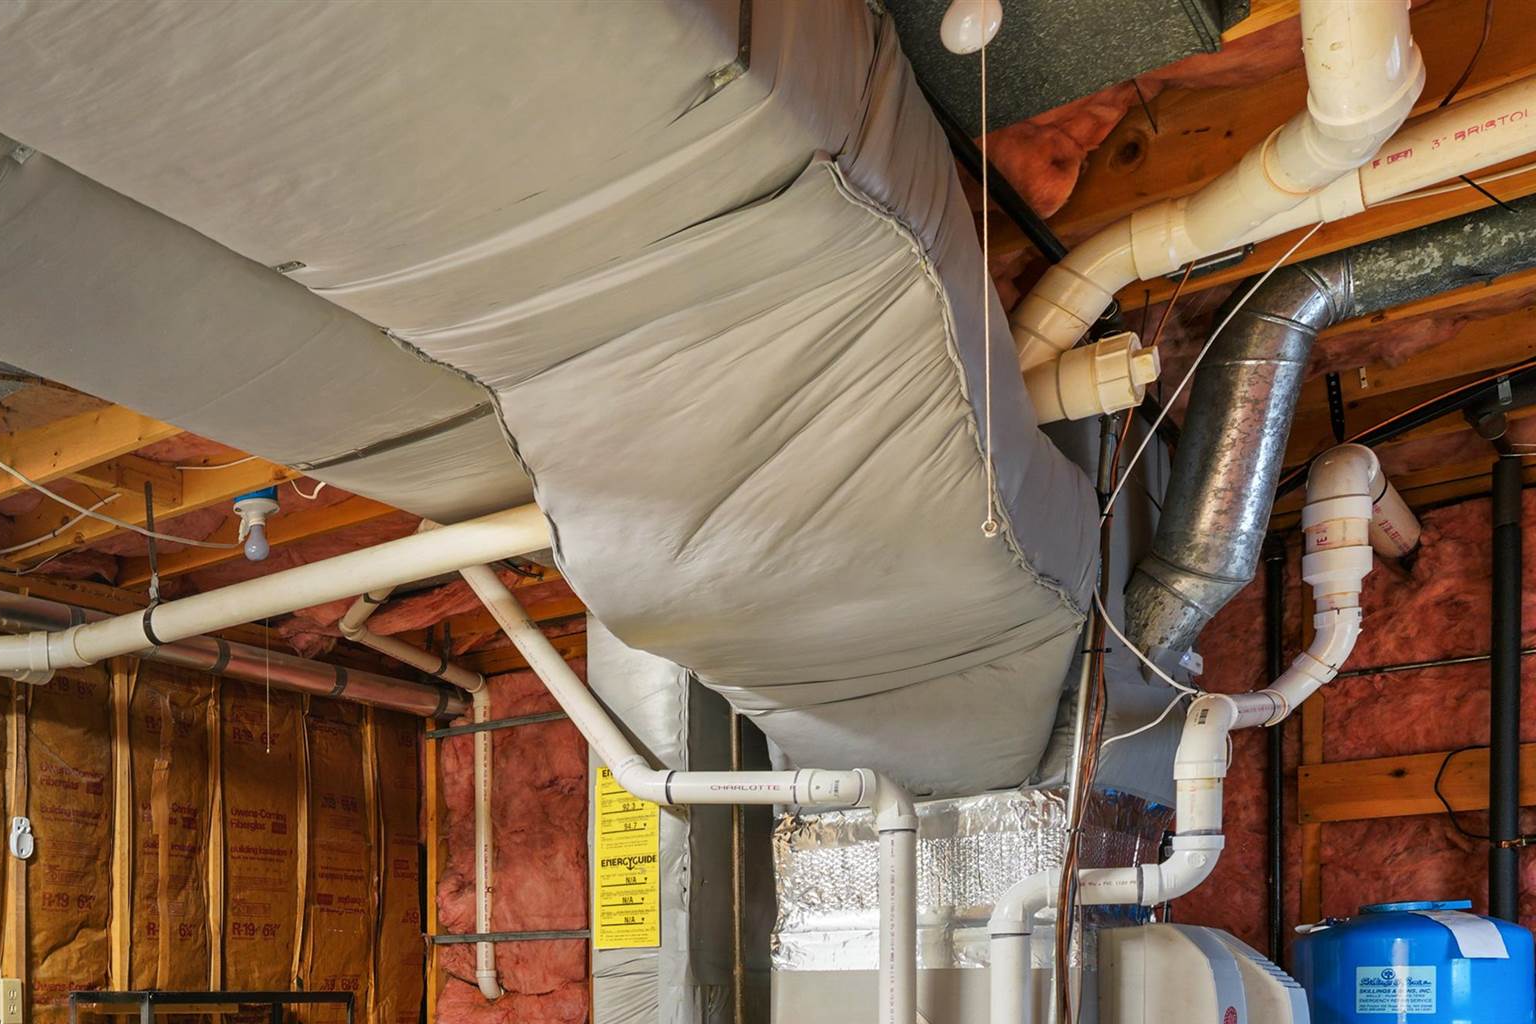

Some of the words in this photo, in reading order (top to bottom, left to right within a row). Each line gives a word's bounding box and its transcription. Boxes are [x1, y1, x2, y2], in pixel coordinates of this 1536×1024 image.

[1454, 108, 1529, 142] BRISTOL
[710, 784, 781, 792] CHARLOTTE
[600, 855, 658, 870] ENERGYGUIDE
[232, 922, 256, 938] R-19
